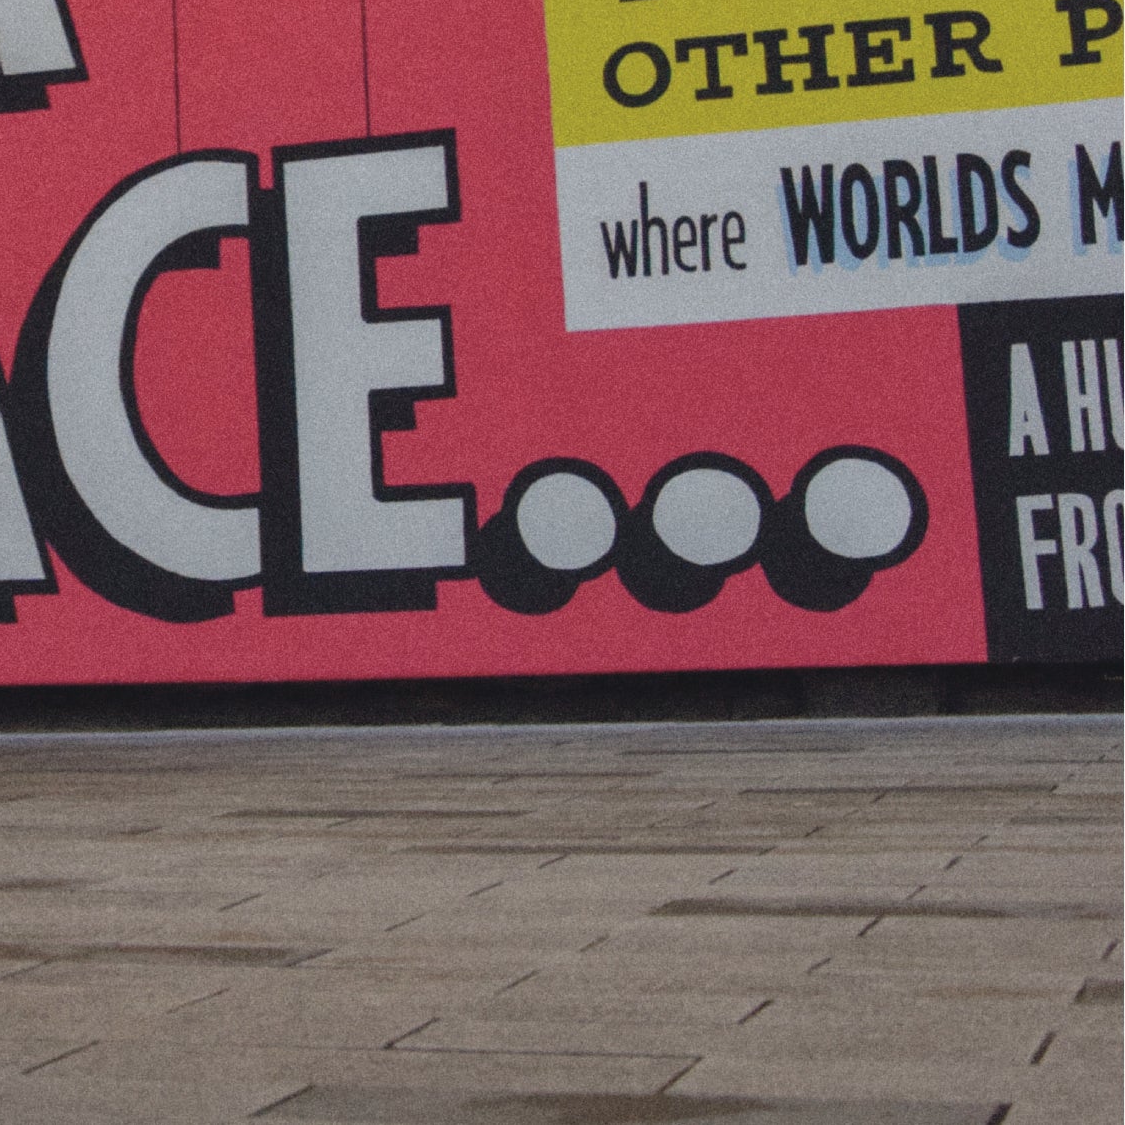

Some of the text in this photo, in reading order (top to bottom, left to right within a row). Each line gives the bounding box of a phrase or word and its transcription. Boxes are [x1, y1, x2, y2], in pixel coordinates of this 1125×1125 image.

[602, 9, 1004, 109] OTHER
[600, 181, 747, 279] where
[777, 149, 1041, 274] WORLDS
[1008, 342, 1050, 457] A
